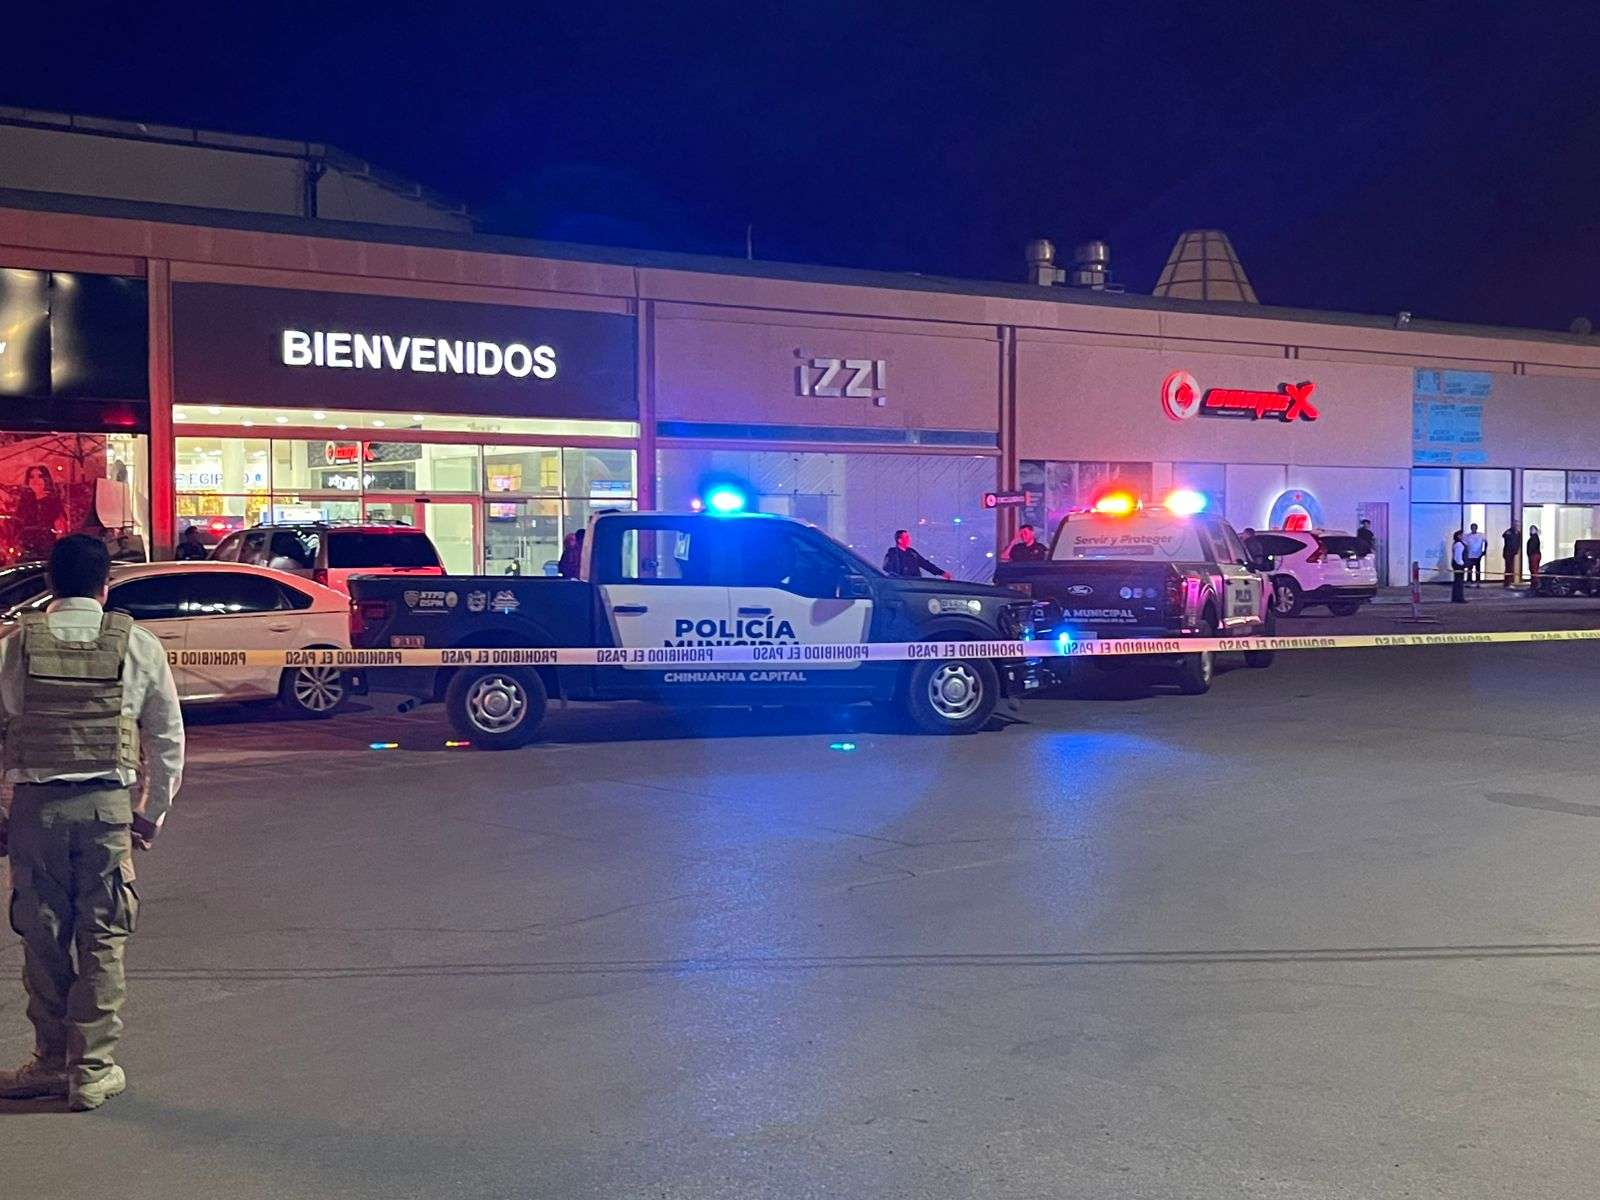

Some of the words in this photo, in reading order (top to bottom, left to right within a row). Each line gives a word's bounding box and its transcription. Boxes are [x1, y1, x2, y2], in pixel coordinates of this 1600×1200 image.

[283, 330, 556, 378] BIENVENIDOS
[1074, 535, 1109, 545] Servir
[1110, 536, 1118, 546] y
[1120, 535, 1174, 546] Proteger
[1073, 609, 1135, 618] MUNICIPAL
[675, 616, 796, 639] POLICÍA
[664, 672, 746, 683] CHIHUAHUA
[749, 671, 807, 682] CAPITAL
